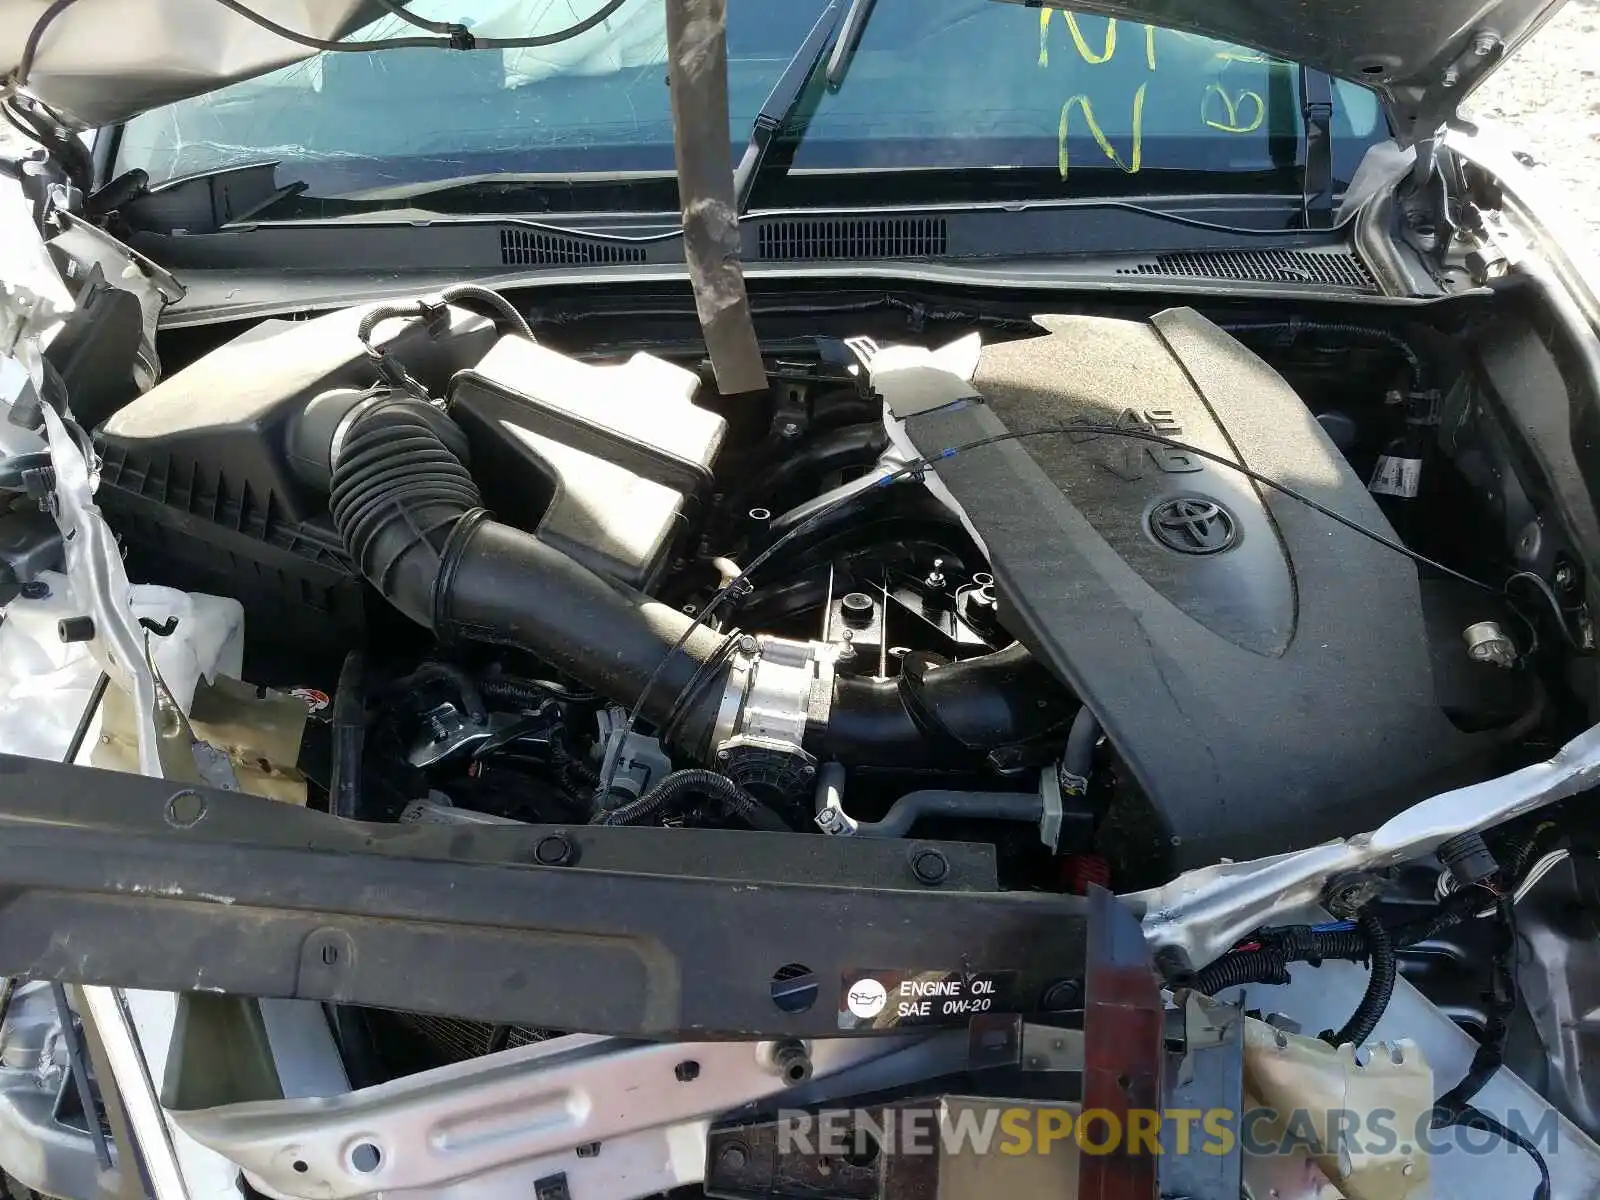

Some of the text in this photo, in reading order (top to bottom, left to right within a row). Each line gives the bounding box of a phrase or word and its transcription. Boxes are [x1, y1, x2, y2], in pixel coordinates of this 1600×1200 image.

[899, 979, 996, 997] ENGINE OIL
[897, 998, 992, 1018] SAE 0W-20
